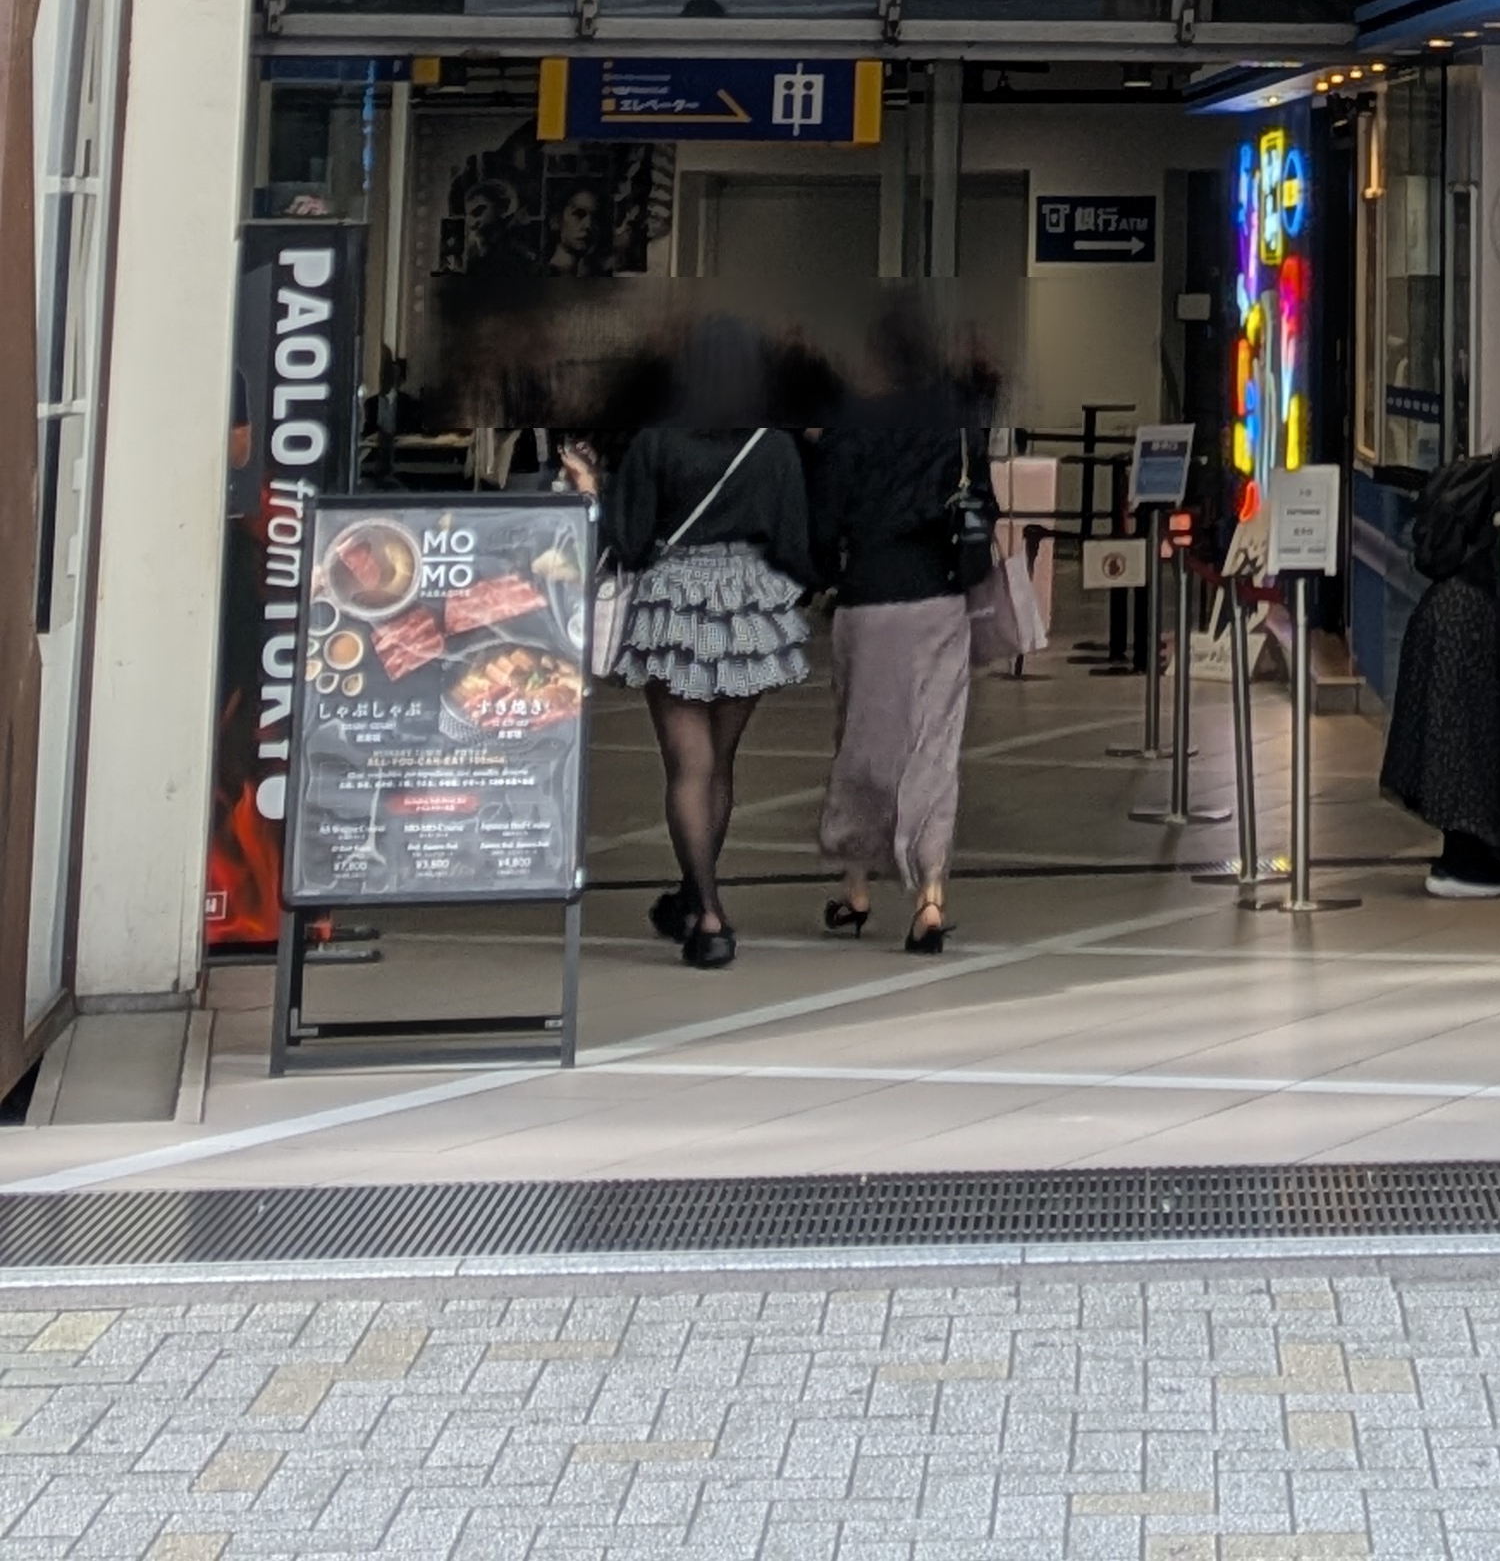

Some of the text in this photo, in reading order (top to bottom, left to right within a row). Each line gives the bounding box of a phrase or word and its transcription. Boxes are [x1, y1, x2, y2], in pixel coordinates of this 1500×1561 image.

[270, 248, 336, 466] PAOLO
[265, 479, 316, 588] from
[422, 530, 475, 555] MO
[421, 564, 474, 589] MO
[318, 699, 422, 720] しゃぶしゃぶ
